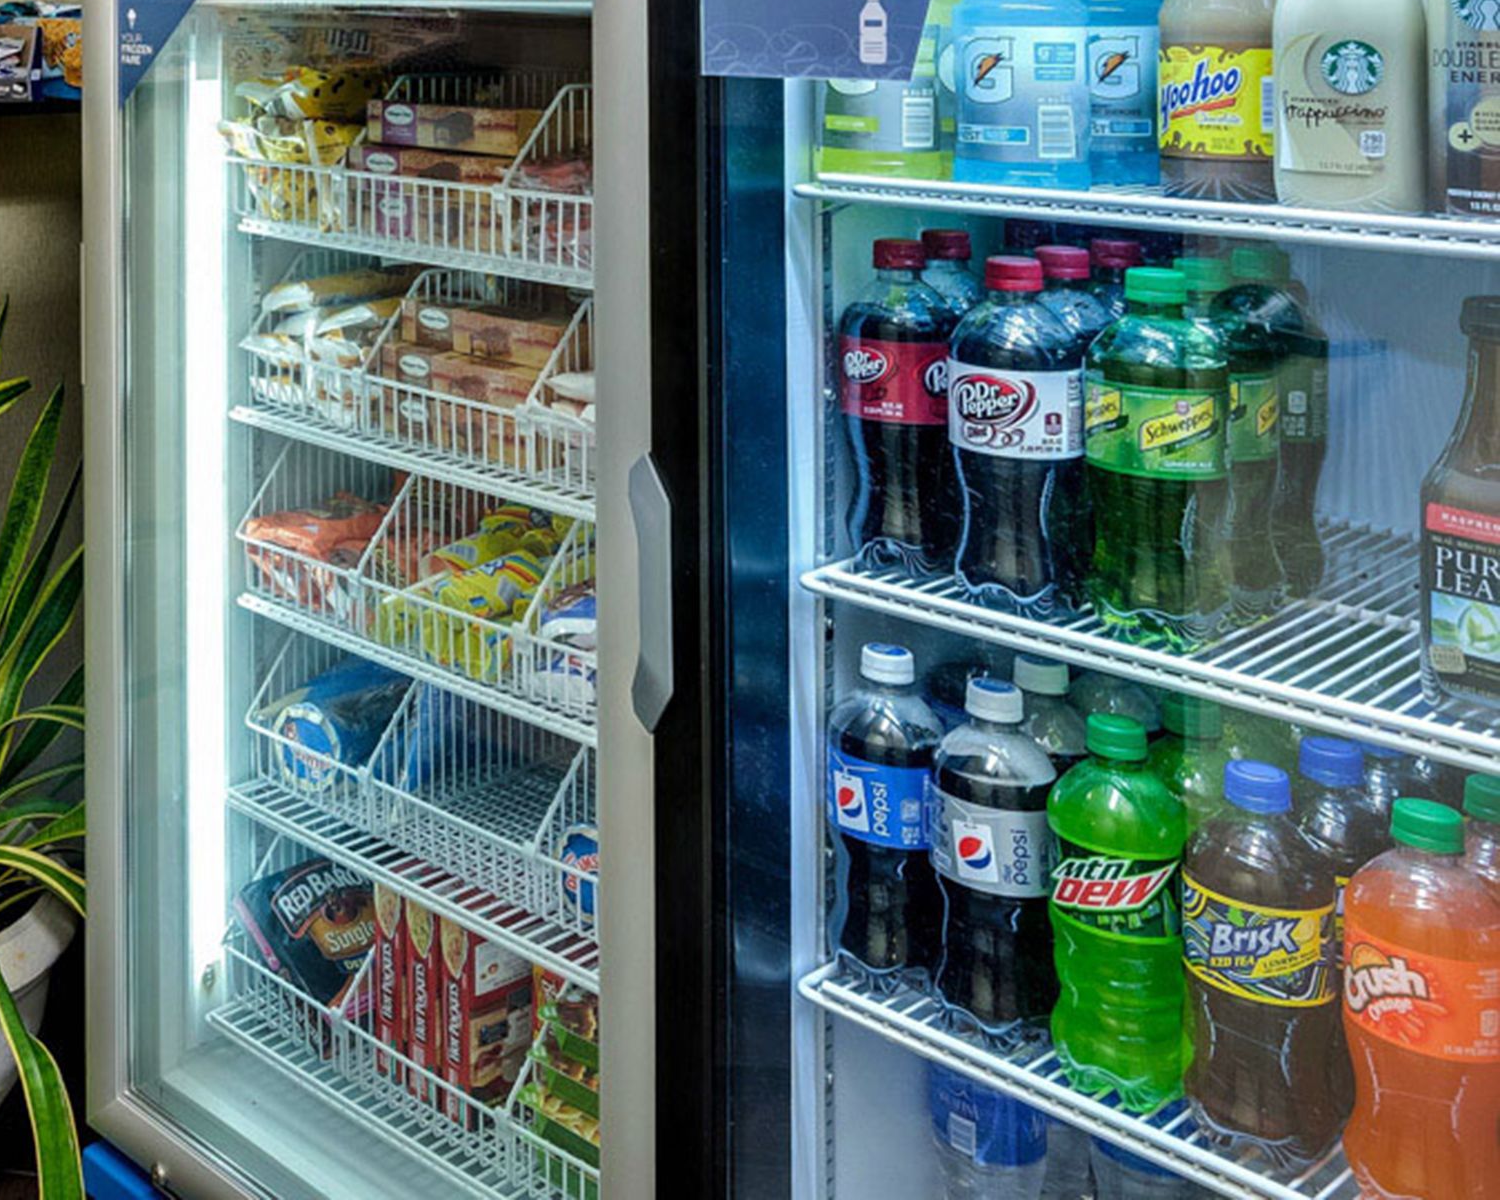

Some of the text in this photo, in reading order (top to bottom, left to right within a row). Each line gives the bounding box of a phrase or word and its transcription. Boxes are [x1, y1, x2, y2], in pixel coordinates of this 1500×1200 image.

[1362, 133, 1384, 145] 290
[961, 382, 1020, 418] Pepper
[975, 381, 1001, 398] Dr
[1143, 405, 1213, 443] Schweppes
[871, 780, 891, 838] pepsi
[1010, 828, 1031, 886] pepsi
[278, 883, 313, 922] RED
[1209, 955, 1255, 967] ICED TEA
[1343, 954, 1430, 1013] Crush
